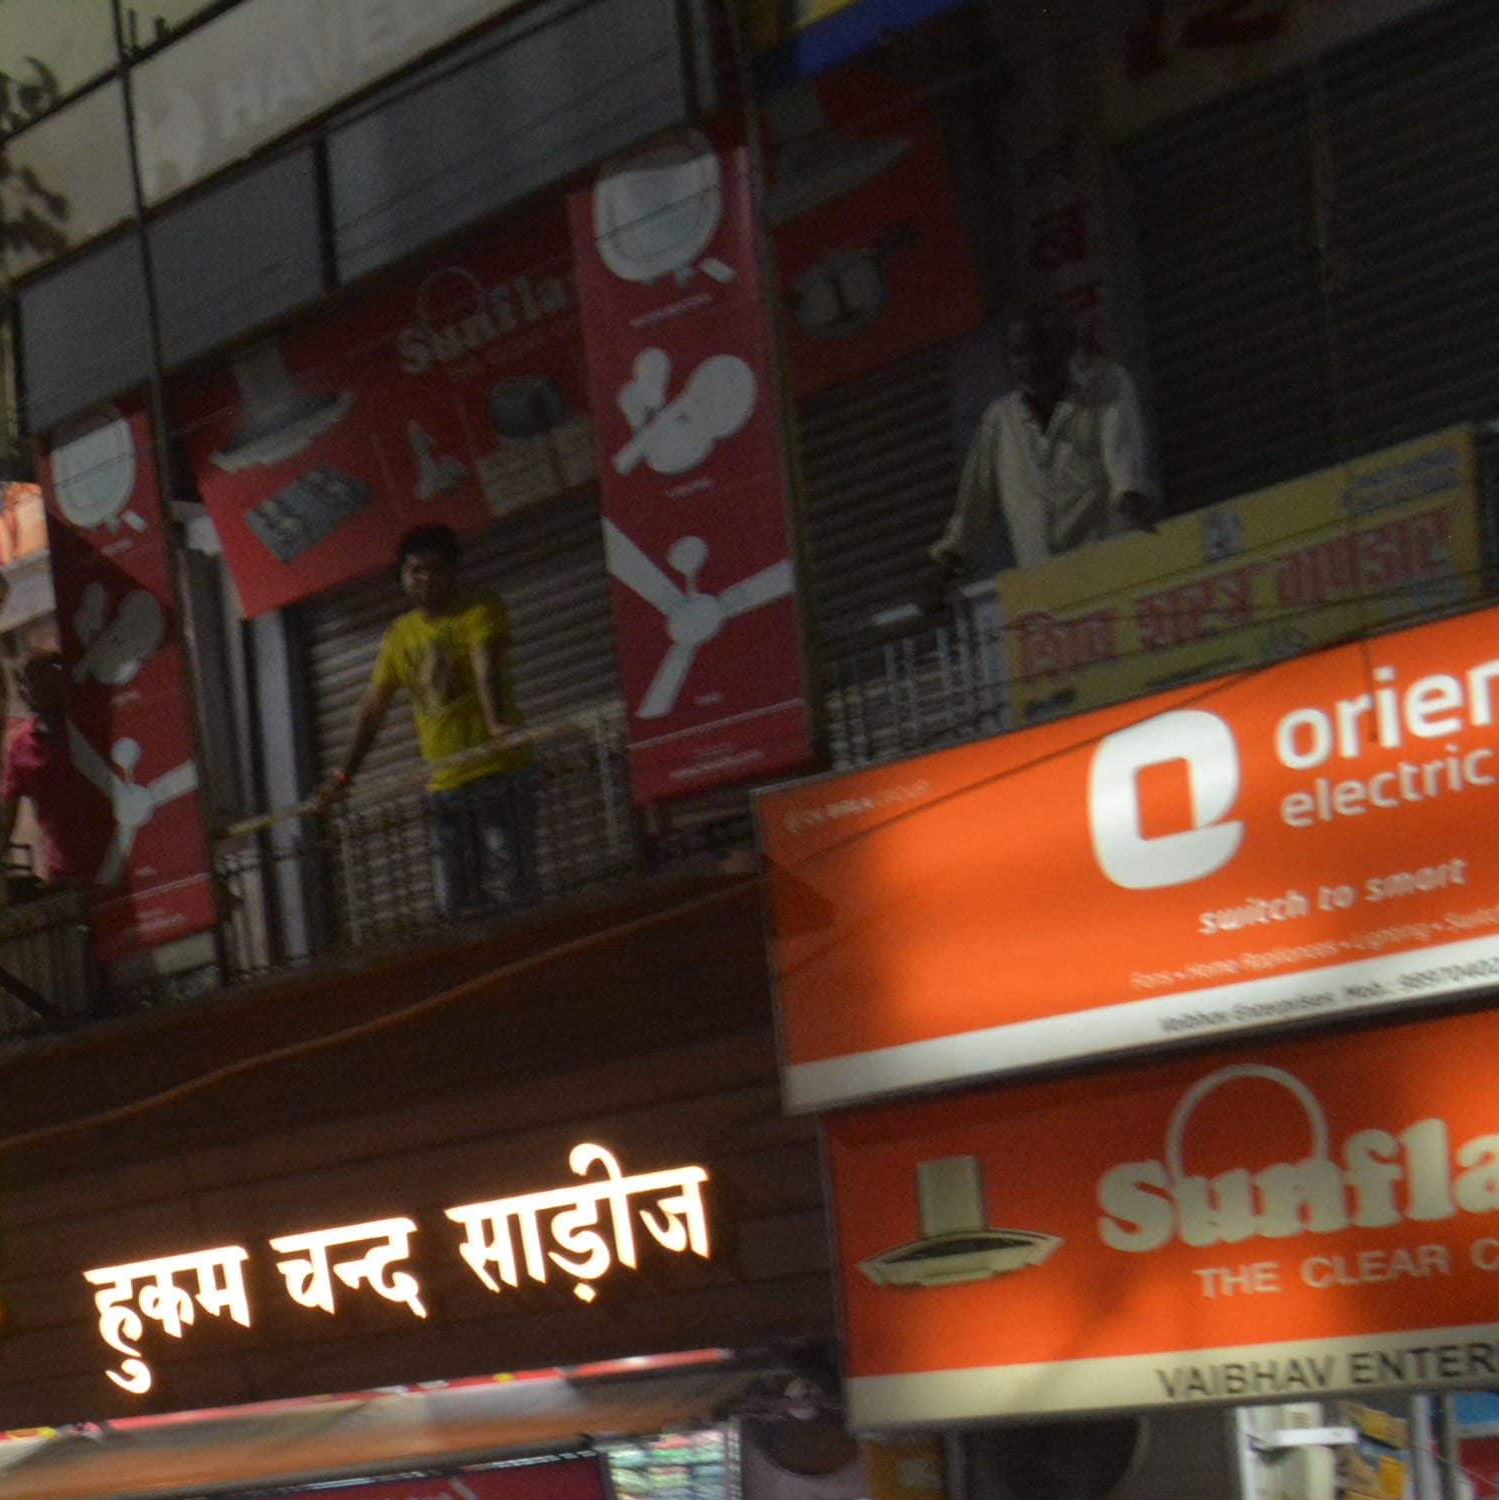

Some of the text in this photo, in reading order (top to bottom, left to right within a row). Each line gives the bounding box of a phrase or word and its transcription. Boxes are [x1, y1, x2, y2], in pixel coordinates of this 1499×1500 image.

[1279, 743, 1496, 828] electric
[1199, 857, 1467, 935] switch to smart
[83, 1142, 710, 1394] हुकम चन्द साड़ीज
[1193, 1260, 1281, 1299] THE
[1300, 1244, 1452, 1289] CLEAR
[1155, 1356, 1337, 1399] VAIBHAV
